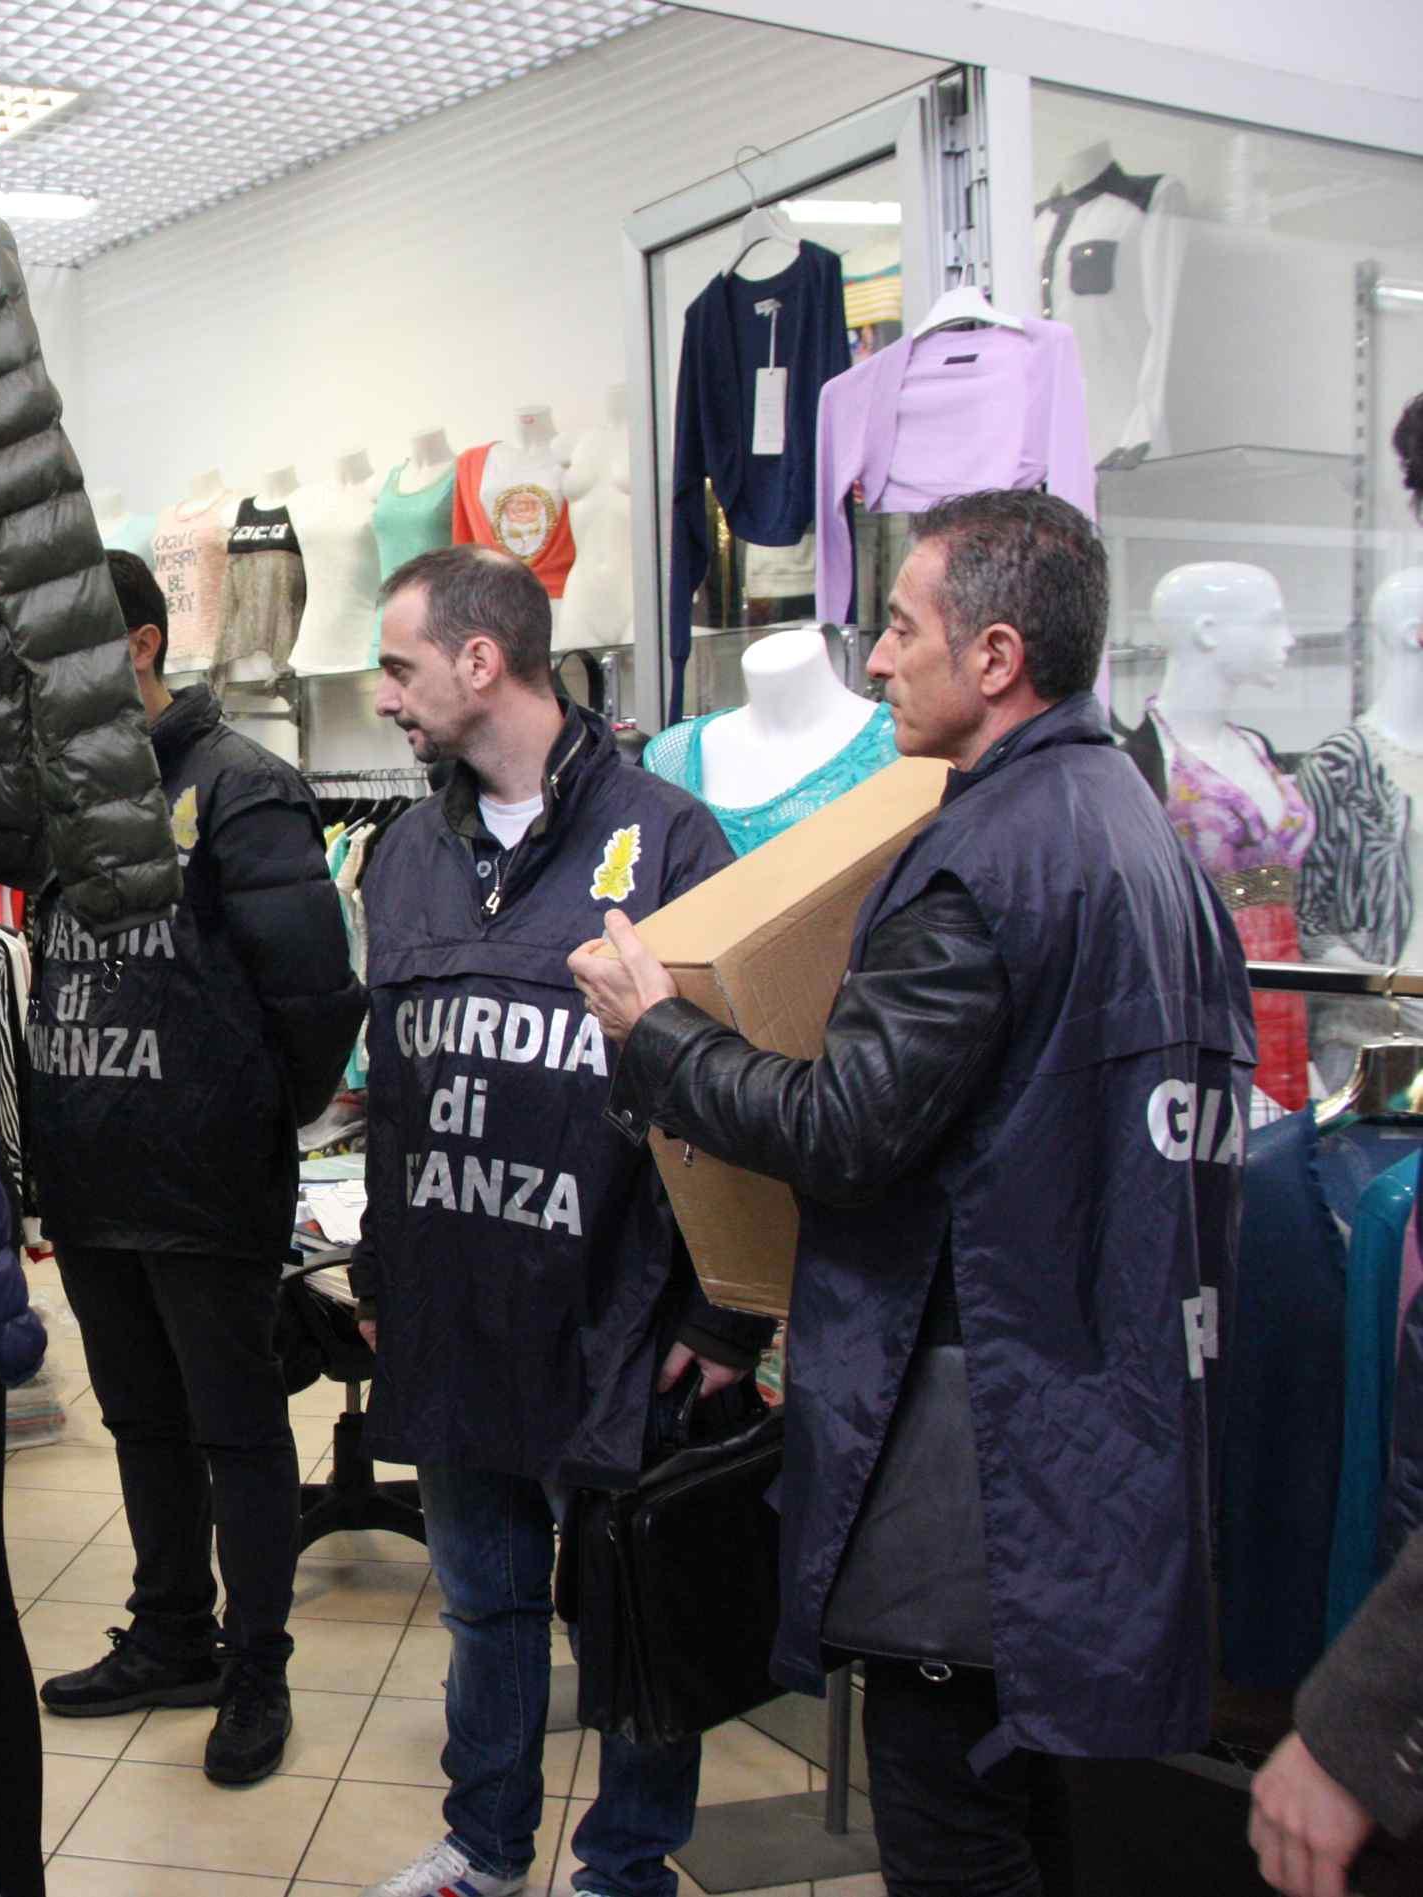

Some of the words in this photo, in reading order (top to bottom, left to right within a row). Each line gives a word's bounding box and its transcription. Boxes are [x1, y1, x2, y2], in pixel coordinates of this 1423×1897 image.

[167, 592, 195, 615] EXY
[56, 973, 92, 1022] di
[395, 996, 610, 1078] GUARDIA
[428, 1075, 489, 1139] di
